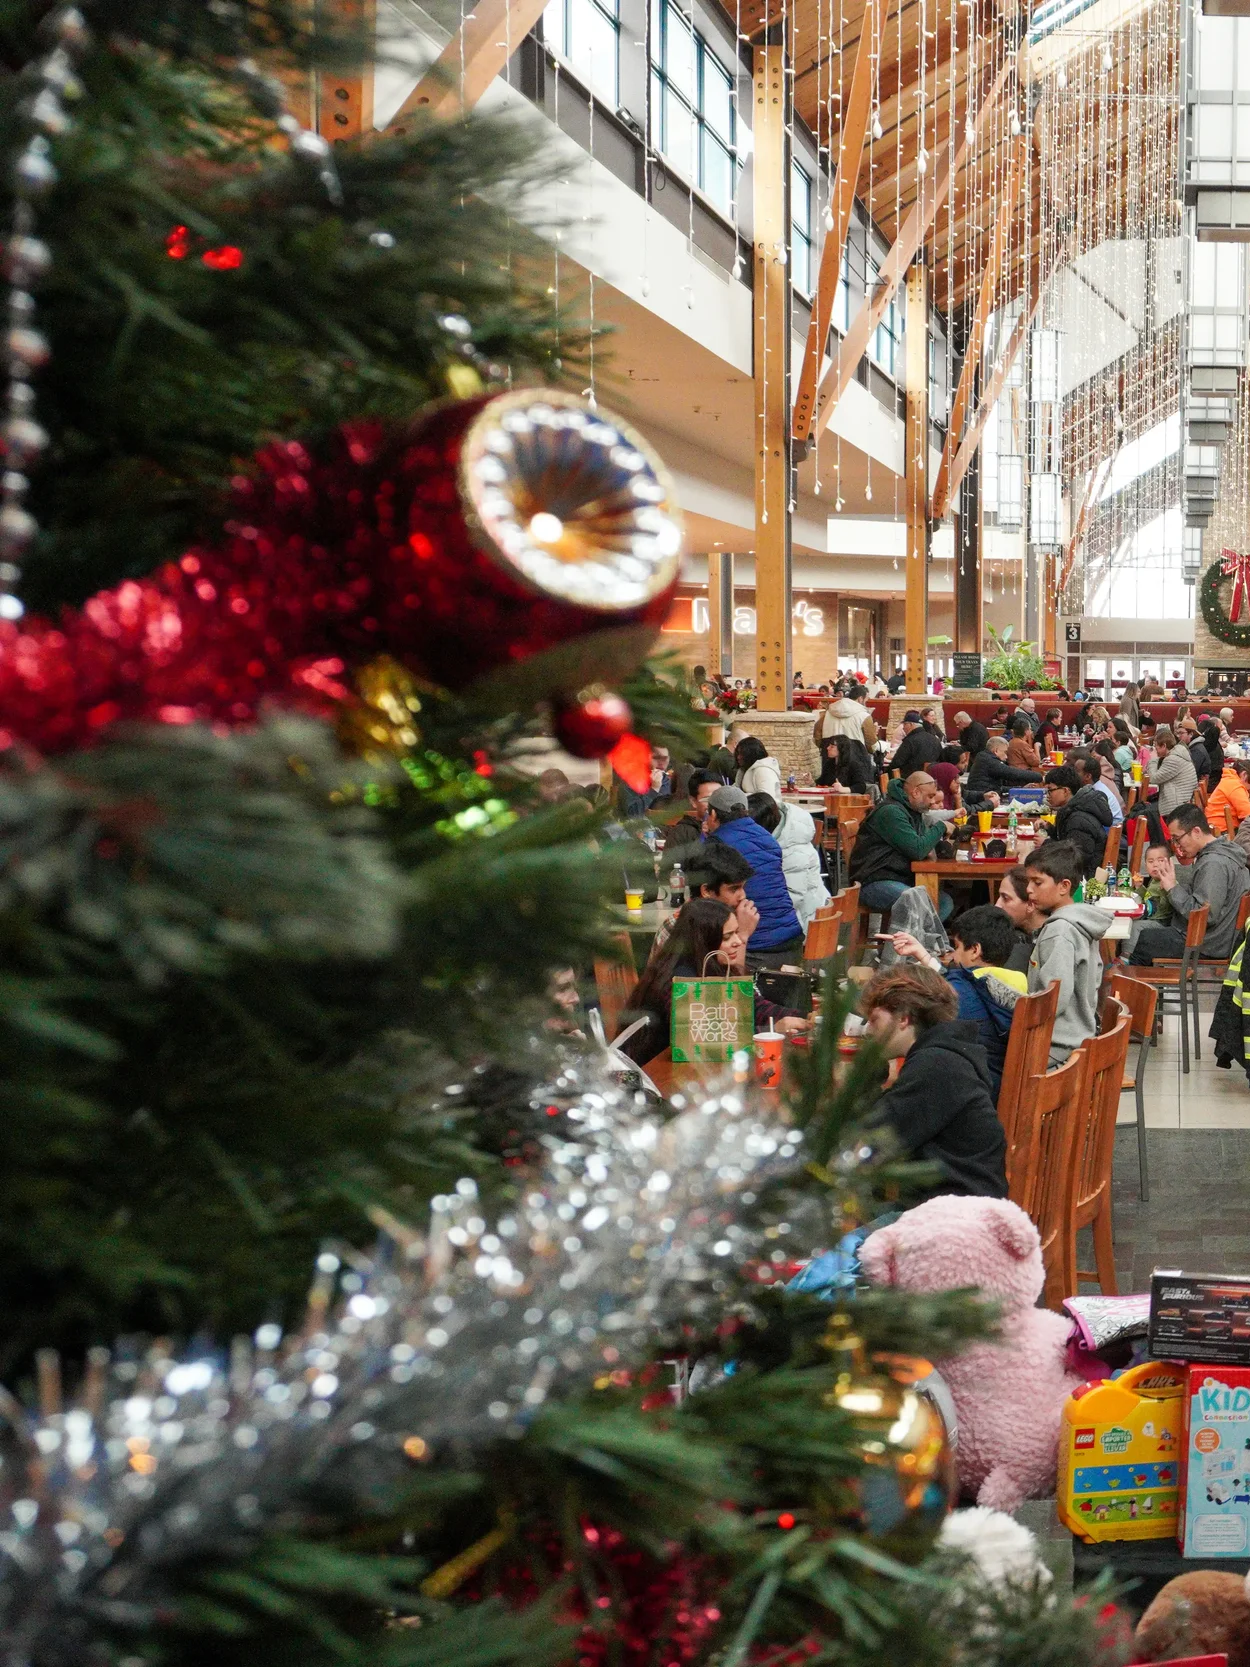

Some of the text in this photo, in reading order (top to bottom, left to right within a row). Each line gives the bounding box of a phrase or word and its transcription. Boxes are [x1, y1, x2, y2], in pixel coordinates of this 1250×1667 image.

[1068, 627, 1078, 640] 3
[689, 1003, 738, 1020] Bath
[689, 1030, 738, 1042] Works
[1160, 1287, 1186, 1295] FAST
[1162, 1293, 1204, 1301] FURIOUS
[1200, 1387, 1250, 1412] KID
[1076, 1434, 1094, 1443] LEGO
